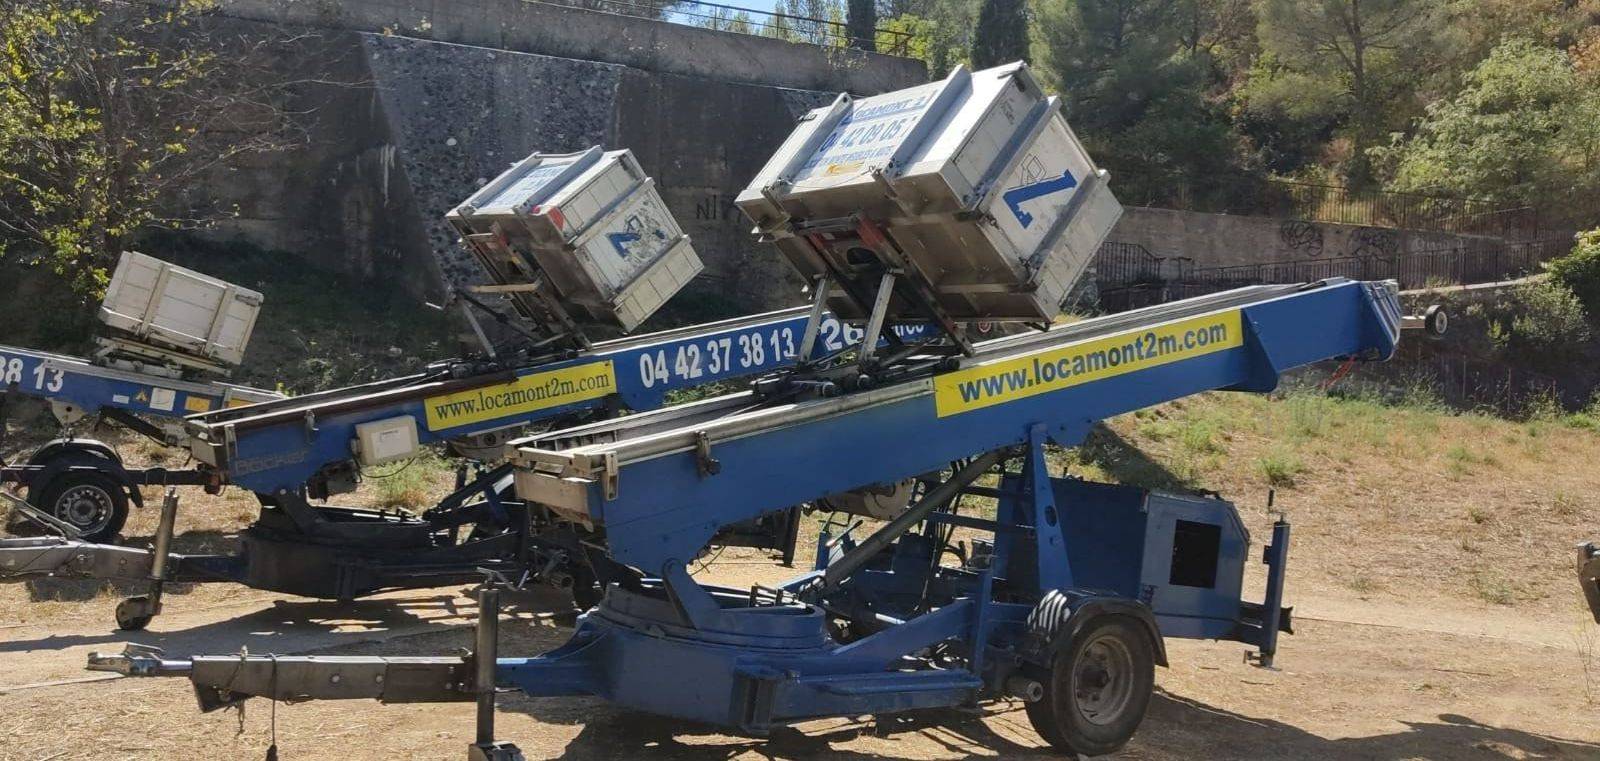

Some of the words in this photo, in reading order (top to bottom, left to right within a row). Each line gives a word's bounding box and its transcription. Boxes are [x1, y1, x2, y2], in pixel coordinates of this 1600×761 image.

[33, 362, 64, 392] 13
[640, 352, 669, 389] 04
[674, 344, 702, 380] 42
[706, 338, 732, 374] 37
[738, 332, 765, 368] 38
[770, 327, 795, 362] 13
[958, 323, 1228, 403] www.locamont2m.com
[435, 371, 610, 421] www.locamont2m.com
